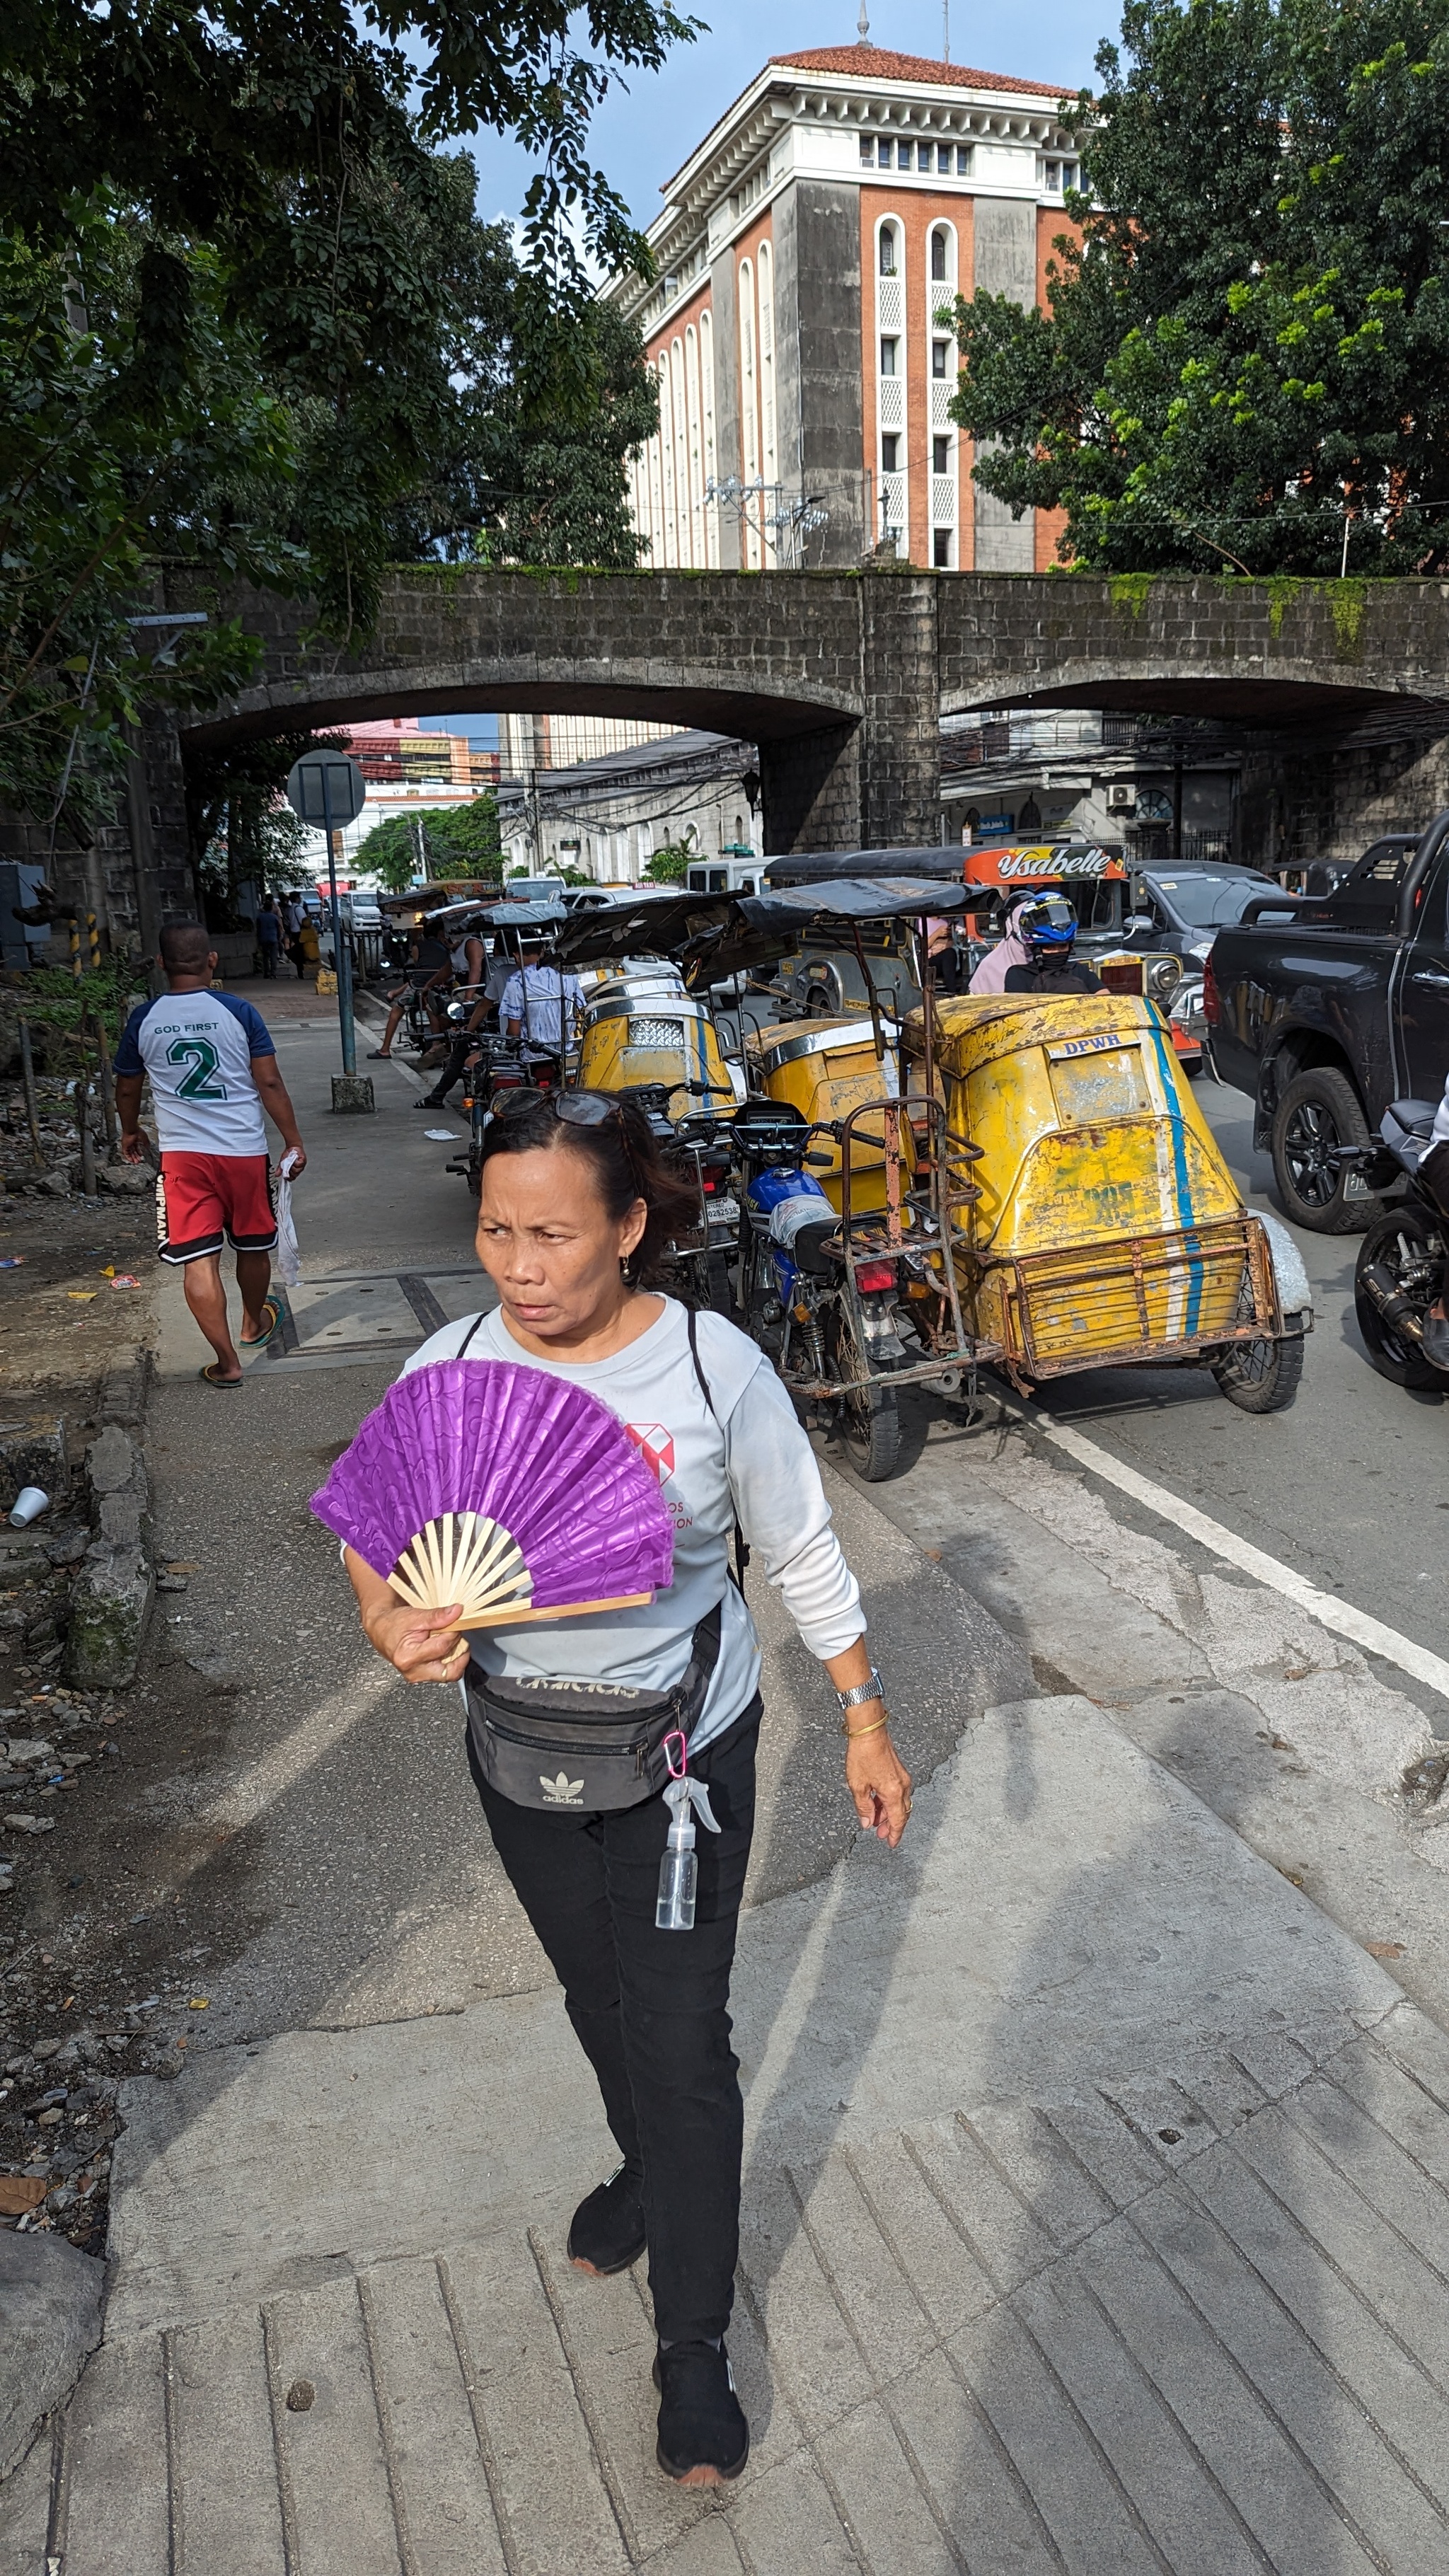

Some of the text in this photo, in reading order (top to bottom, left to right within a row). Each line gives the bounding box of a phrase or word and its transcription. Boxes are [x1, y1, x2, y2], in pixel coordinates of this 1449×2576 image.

[998, 849, 1112, 879] Ysabelle
[154, 1022, 219, 1034] GOD FIRST
[1063, 1034, 1122, 1055] DPWH
[166, 1036, 228, 1101] 2
[542, 1794, 584, 1805] adidas
